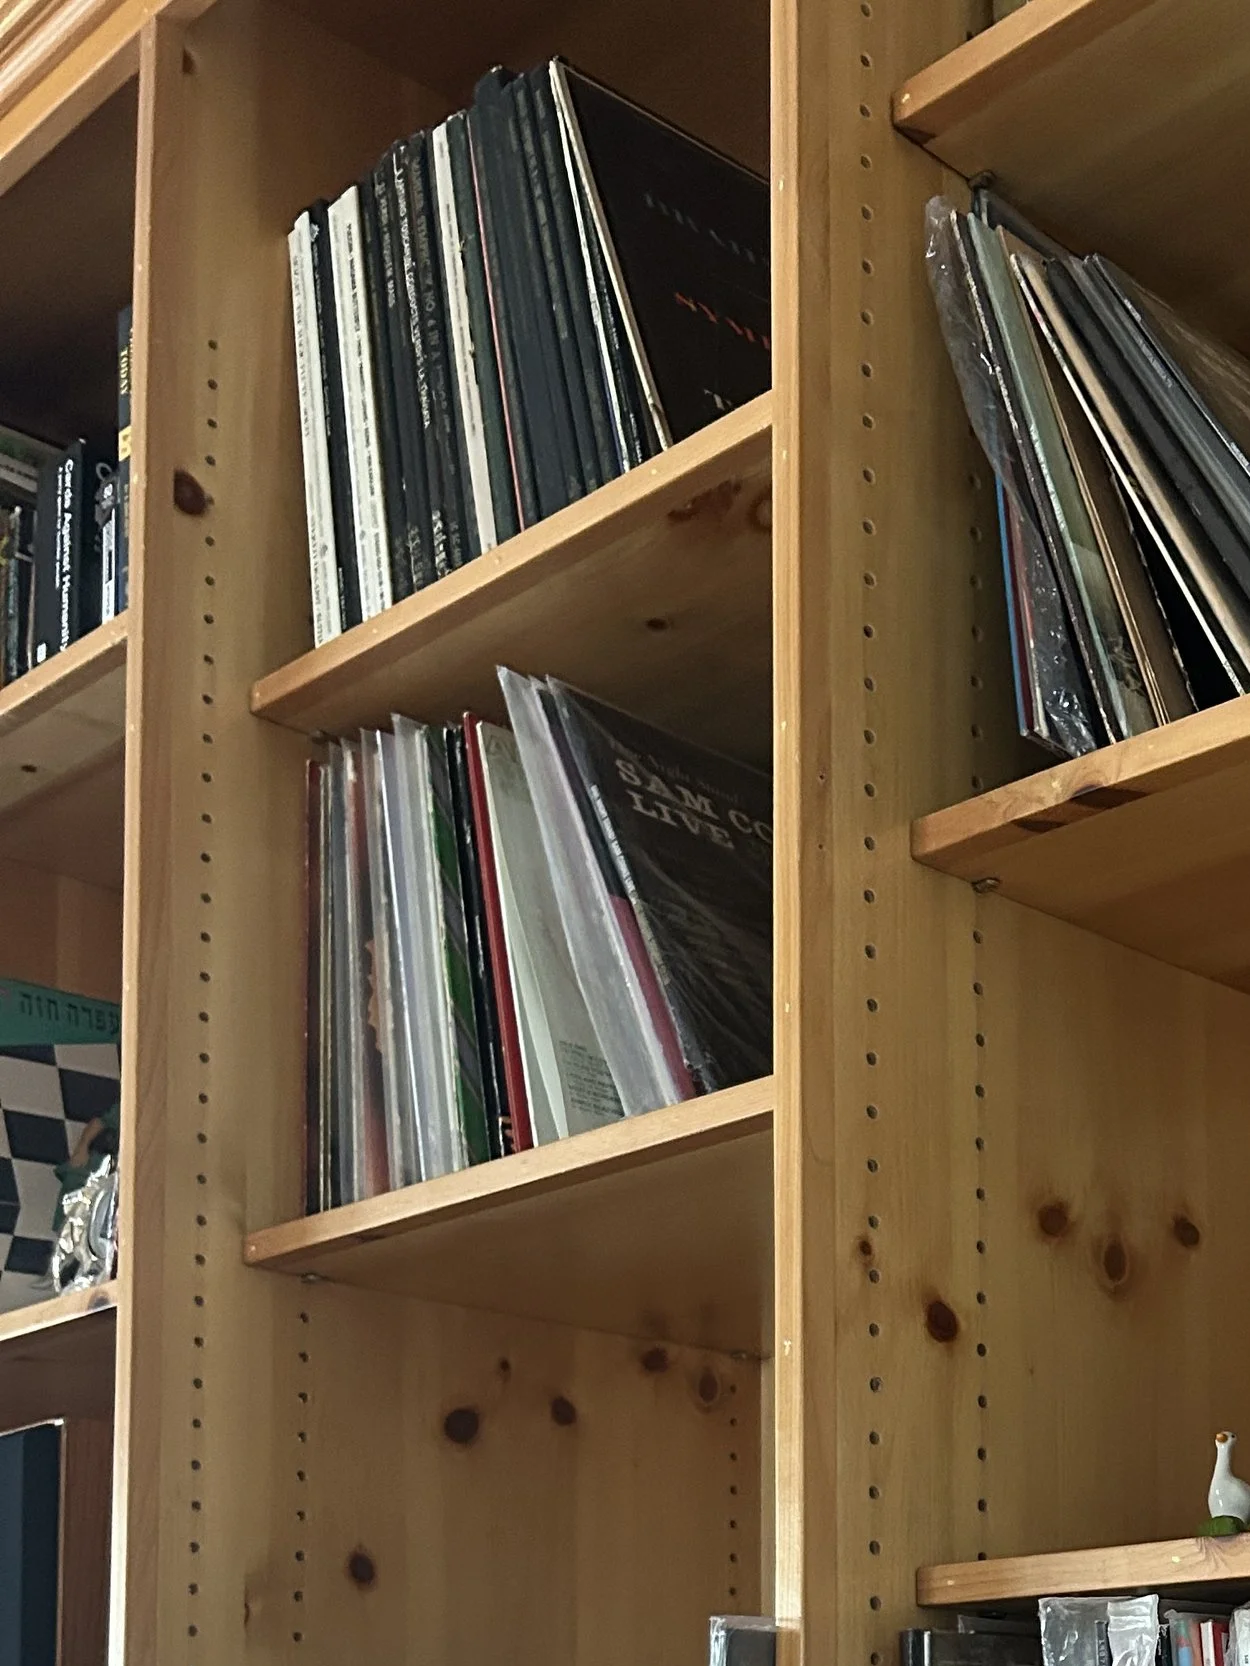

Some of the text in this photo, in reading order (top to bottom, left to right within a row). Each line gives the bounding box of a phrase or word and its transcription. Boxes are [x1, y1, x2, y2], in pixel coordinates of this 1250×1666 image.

[60, 459, 74, 651] Cards Against Humanity
[615, 758, 720, 820] SAM
[624, 788, 735, 849] LIVE
